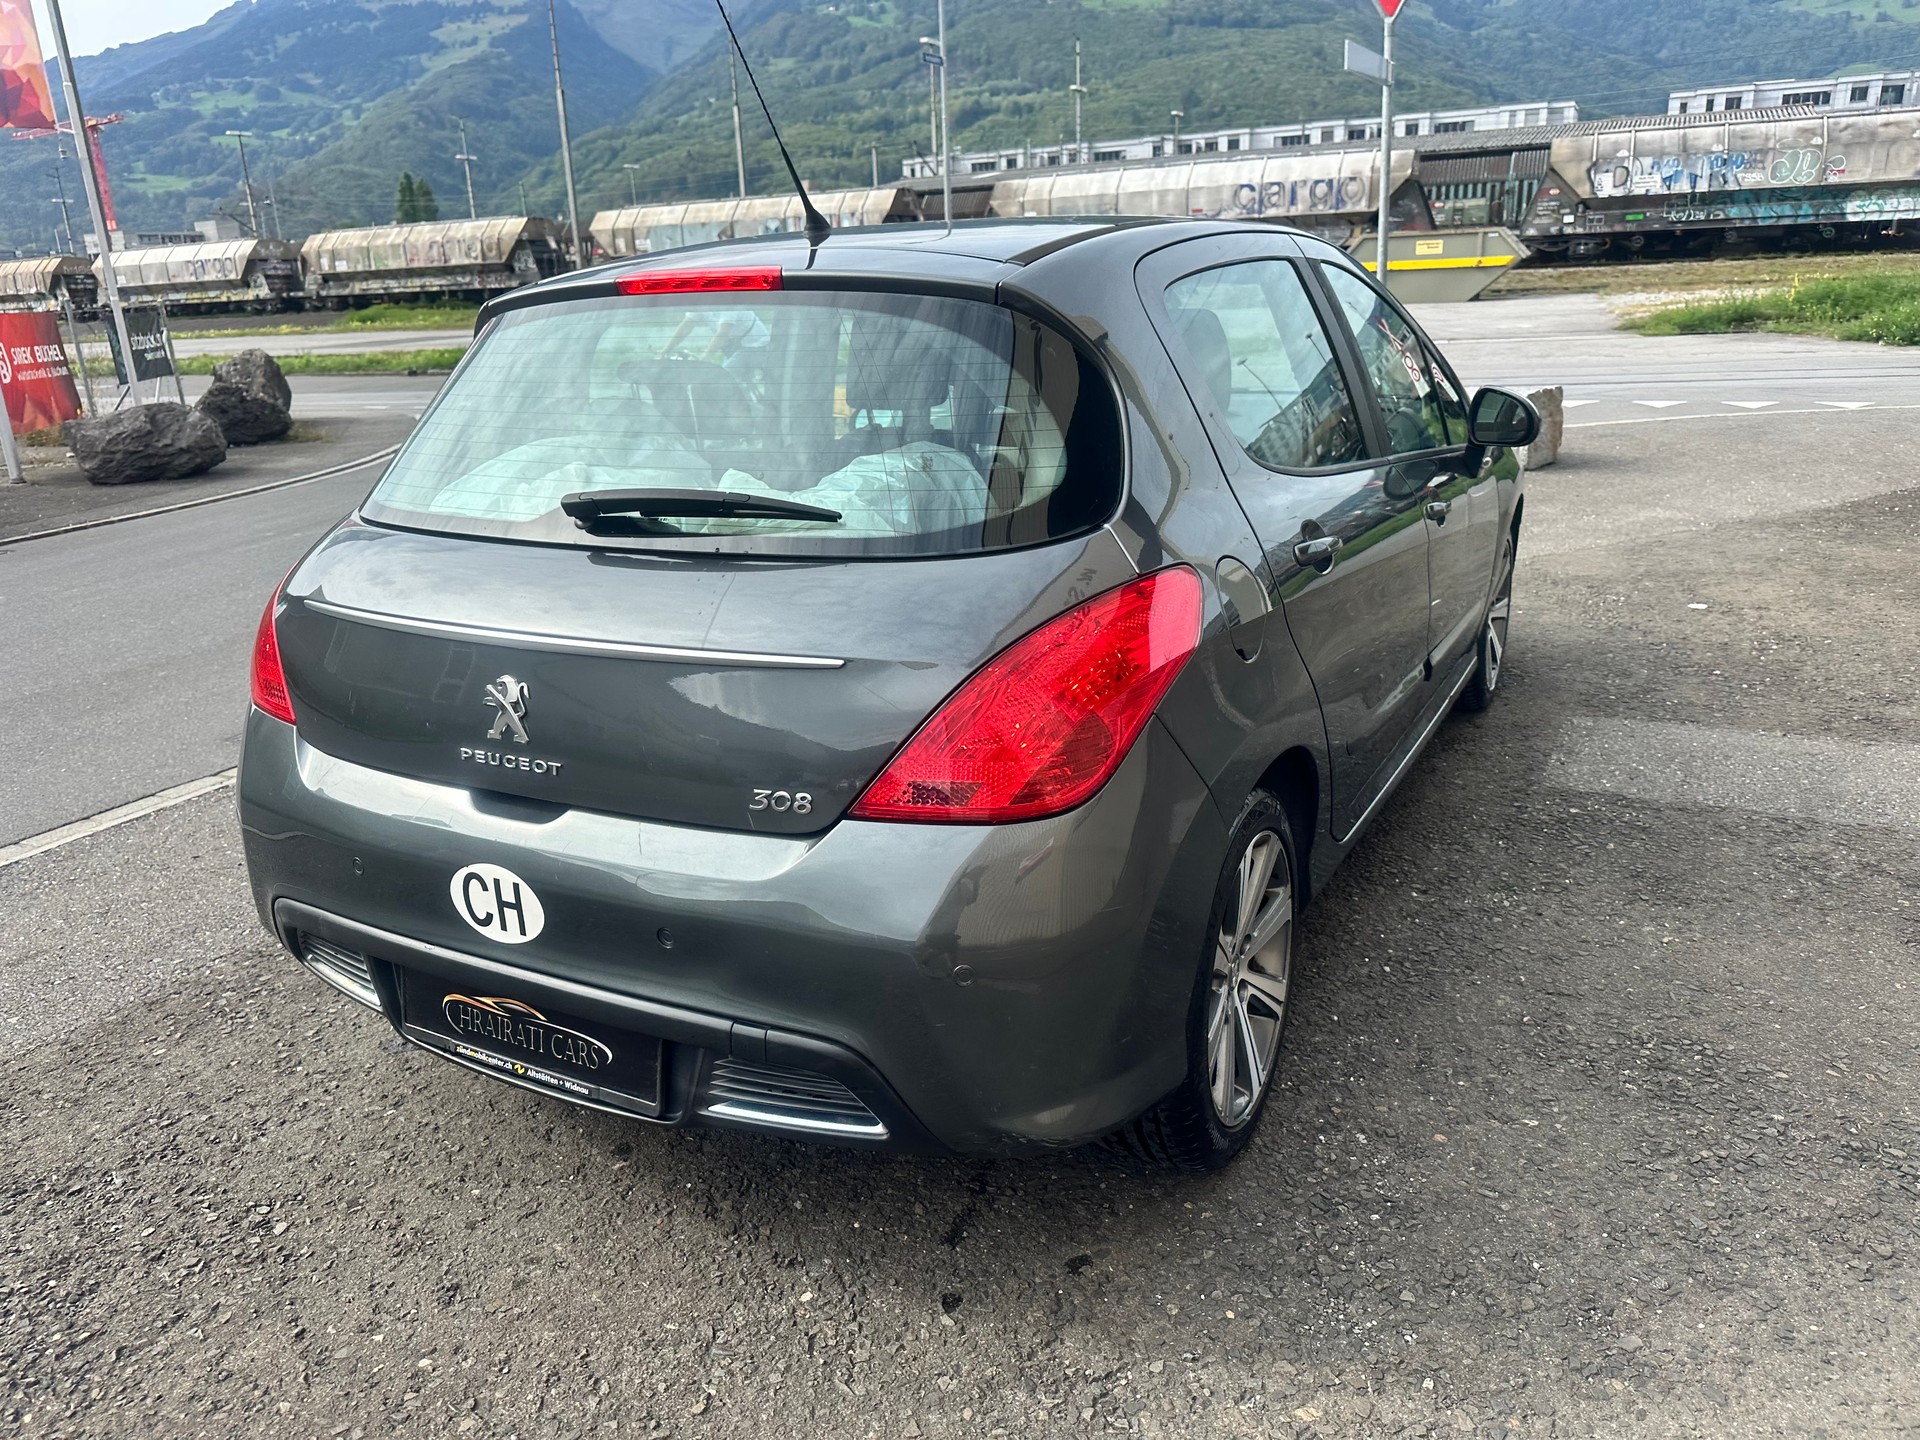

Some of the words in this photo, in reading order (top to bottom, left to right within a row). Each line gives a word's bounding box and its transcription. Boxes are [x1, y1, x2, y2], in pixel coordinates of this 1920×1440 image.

[1233, 176, 1366, 213] cargo
[460, 747, 562, 776] PEUGEOT
[749, 788, 812, 815] 308
[462, 871, 527, 937] CH
[459, 1004, 545, 1054] HRAIRATI
[551, 1033, 600, 1070] CARS
[456, 1045, 513, 1070] zündmobilcenter.ch
[526, 1067, 559, 1086] Altstätten
[563, 1079, 590, 1096] Widnau
